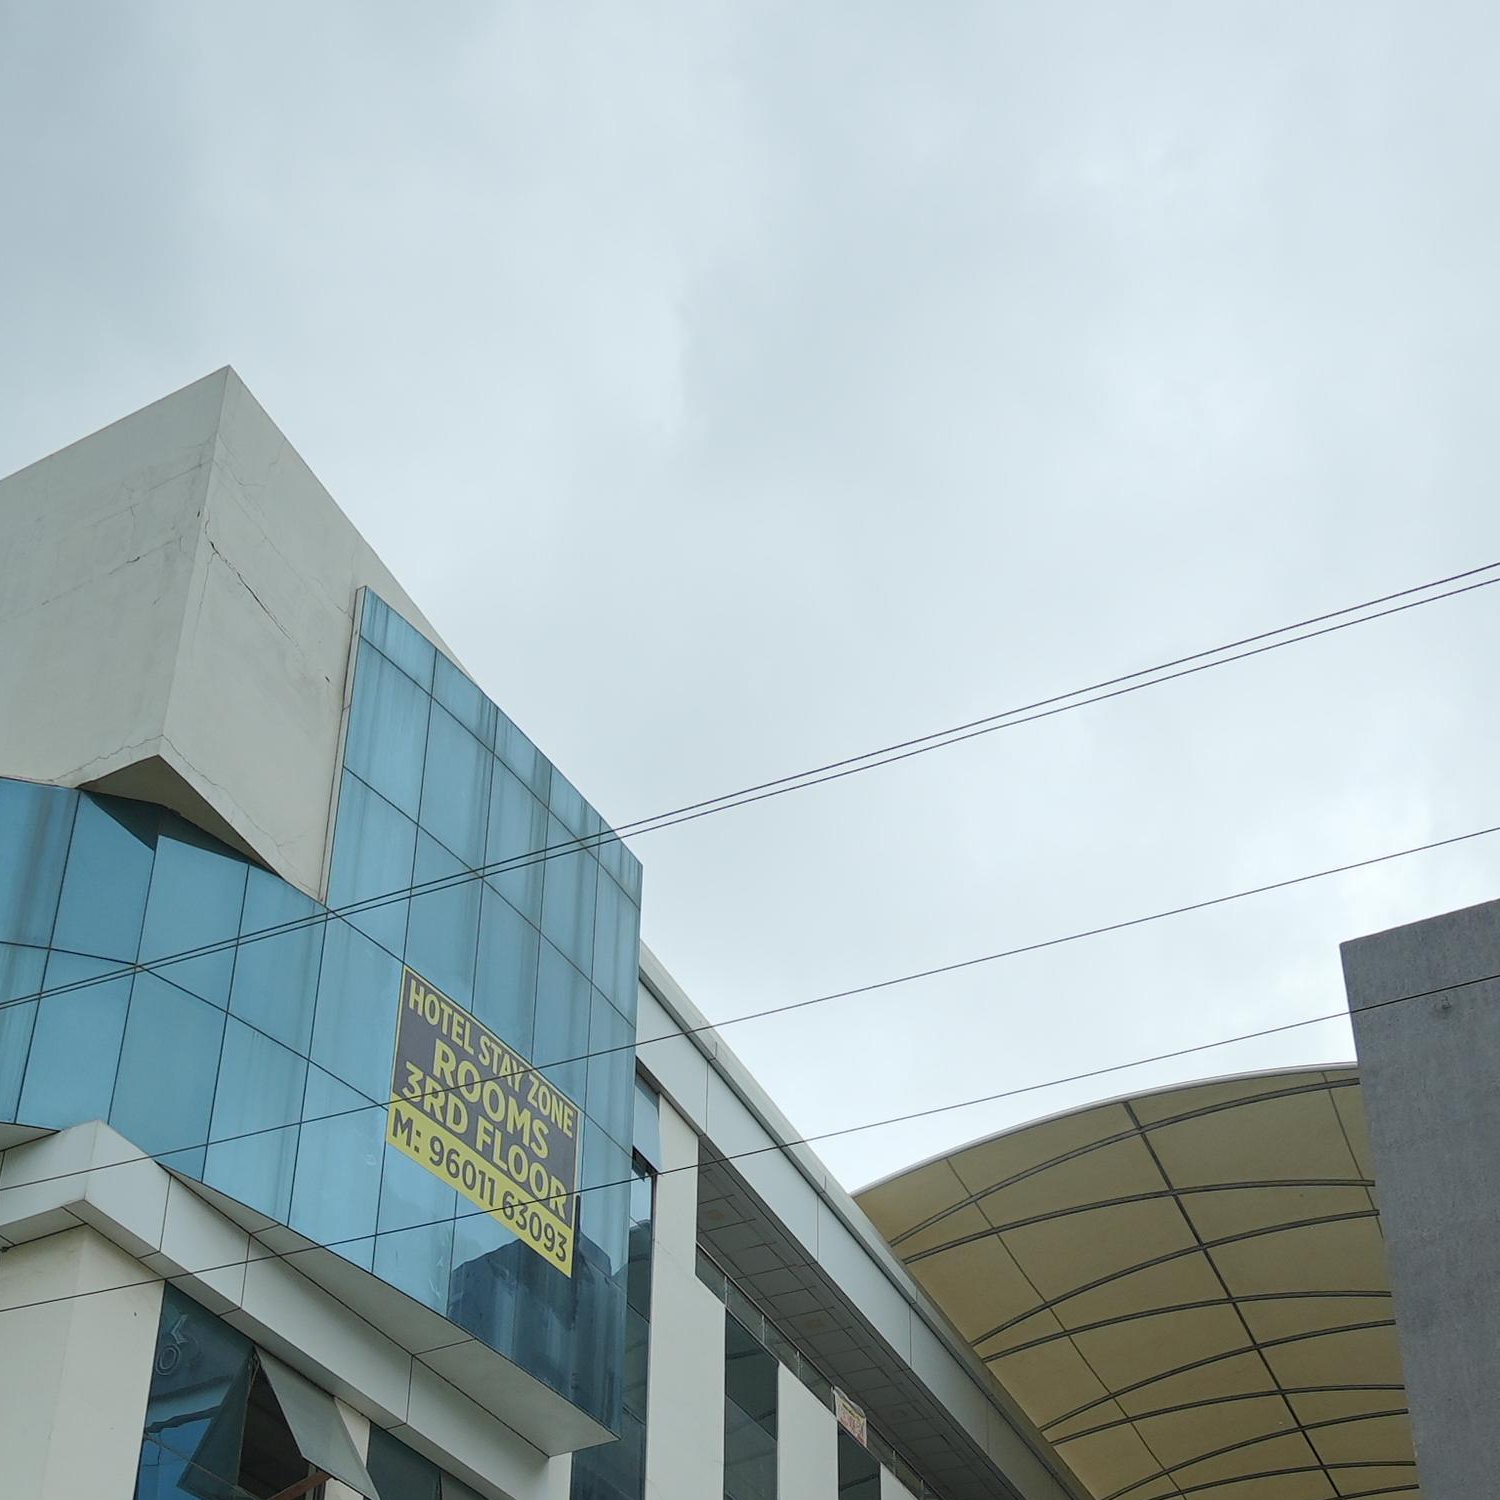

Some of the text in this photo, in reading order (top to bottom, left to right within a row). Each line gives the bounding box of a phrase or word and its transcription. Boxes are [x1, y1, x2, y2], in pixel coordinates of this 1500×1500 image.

[408, 978, 573, 1138] HOTEL STAY ZONE
[433, 1037, 549, 1159] ROOMS
[392, 1106, 568, 1263] M: 96011 63093
[402, 1061, 567, 1220] 3RD FLOOR
